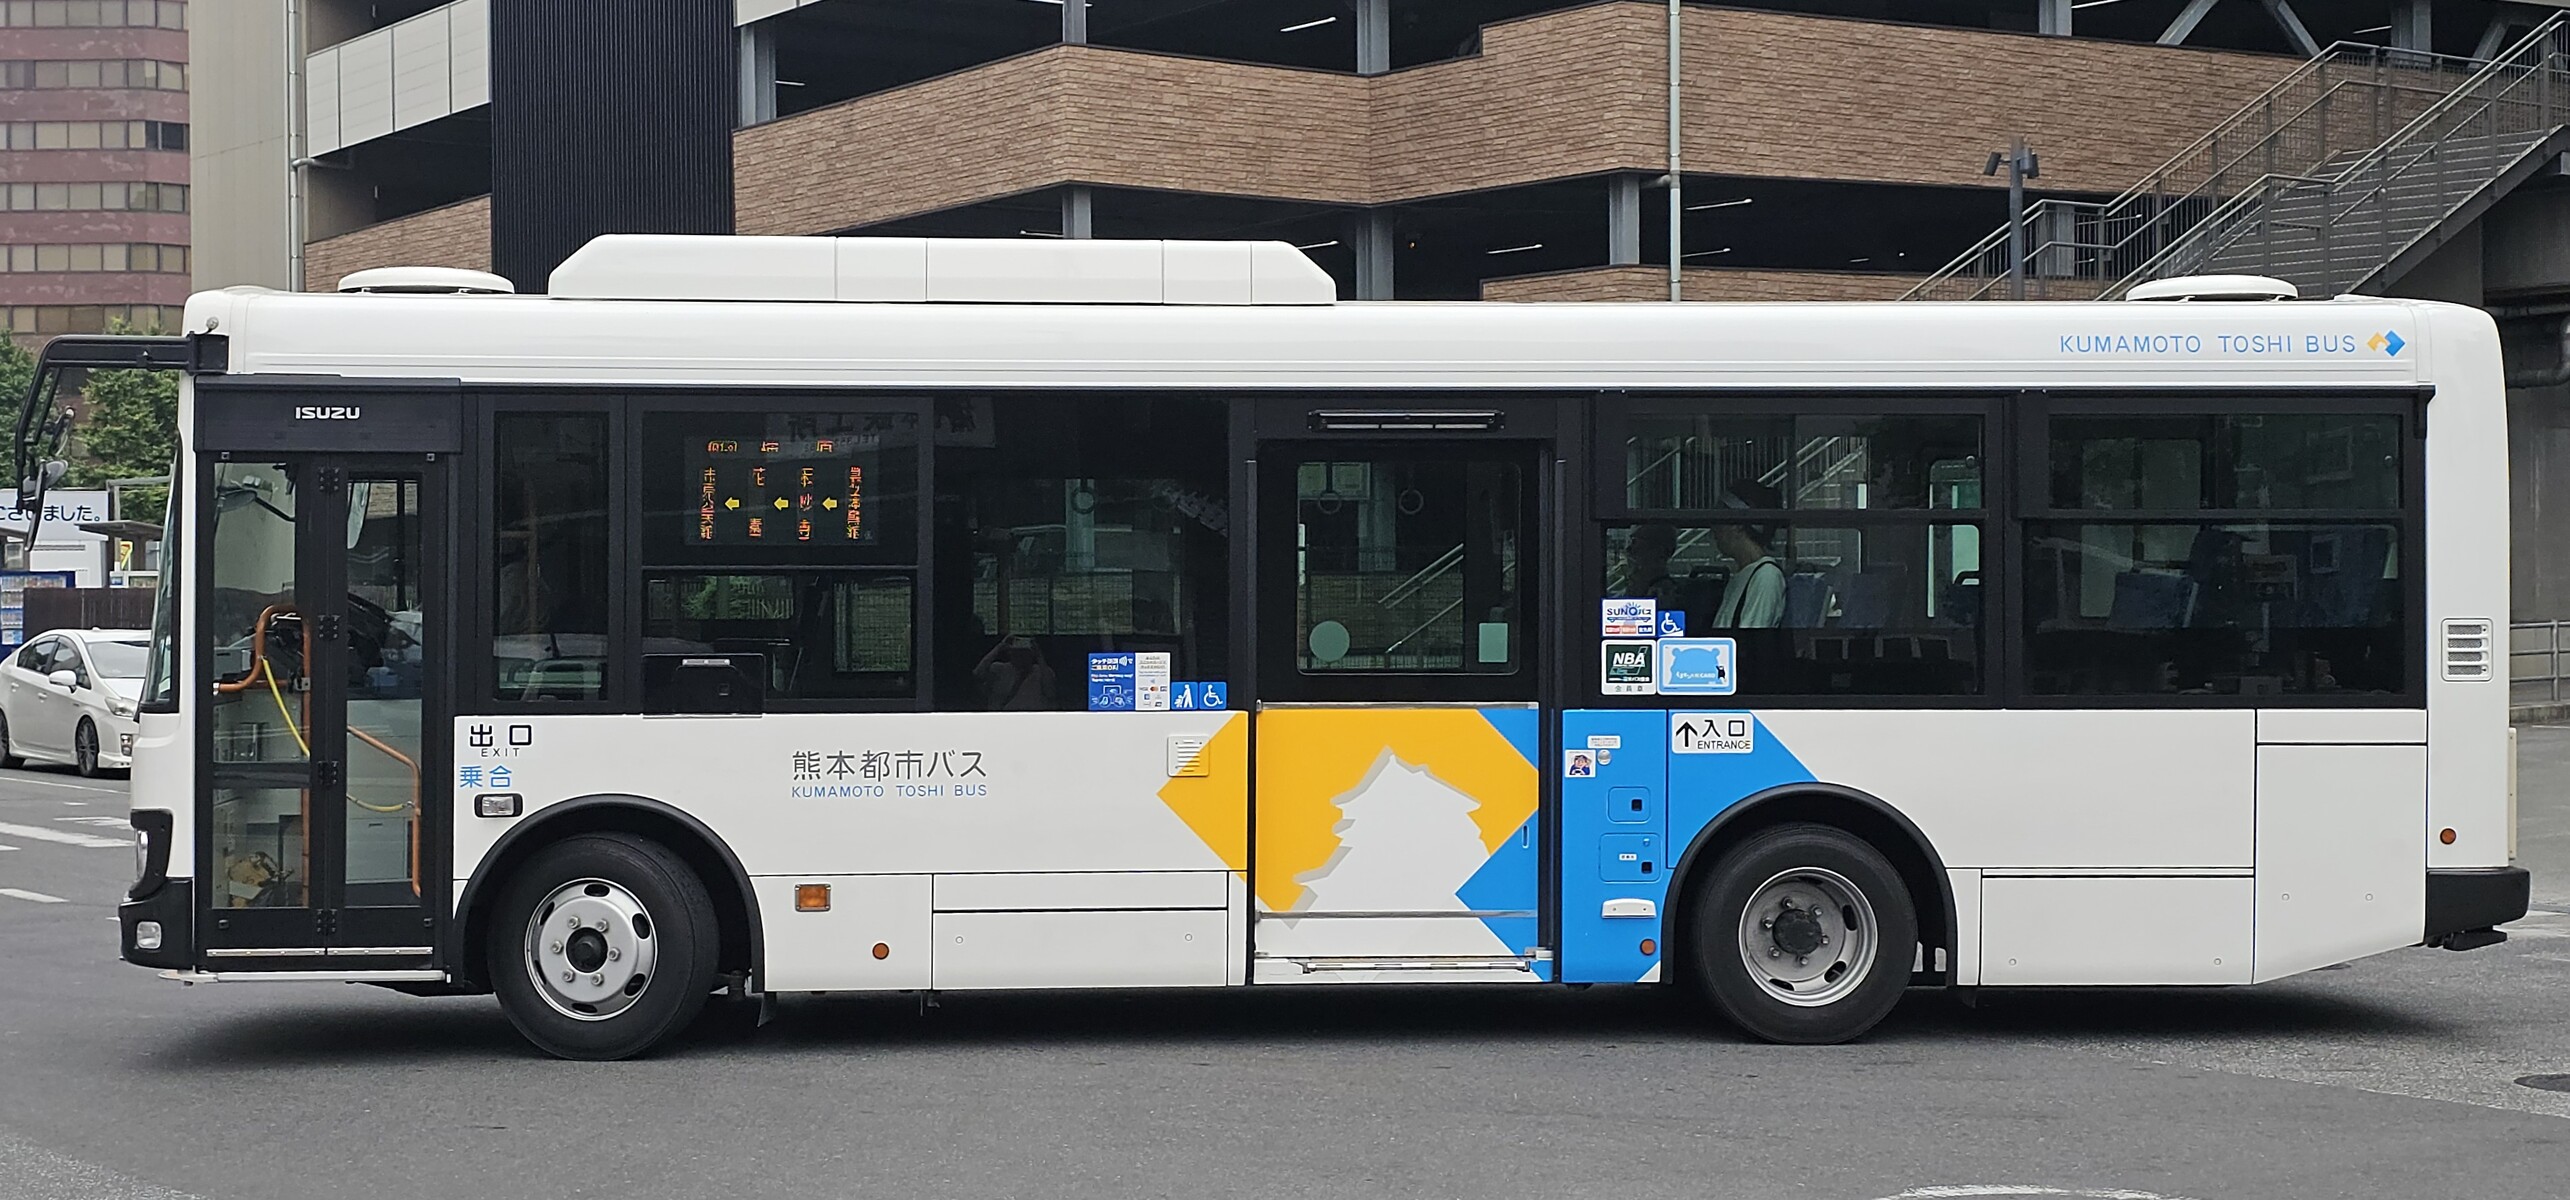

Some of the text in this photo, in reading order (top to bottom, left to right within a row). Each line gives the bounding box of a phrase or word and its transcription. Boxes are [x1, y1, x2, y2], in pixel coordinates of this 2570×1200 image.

[2059, 335, 2356, 353] KUMAMOTO TOSHI BUS
[295, 406, 361, 420] ISUZU
[1613, 652, 1645, 665] NBA
[469, 723, 533, 747] 出口
[1702, 719, 1745, 738] 入口
[481, 748, 520, 757] EXIT
[1697, 740, 1751, 750] ENTRANCE
[792, 750, 987, 782] 熊本都市バス
[460, 765, 513, 788] 乗合
[791, 784, 987, 798] KUMAMOTO TOSHI BUS
